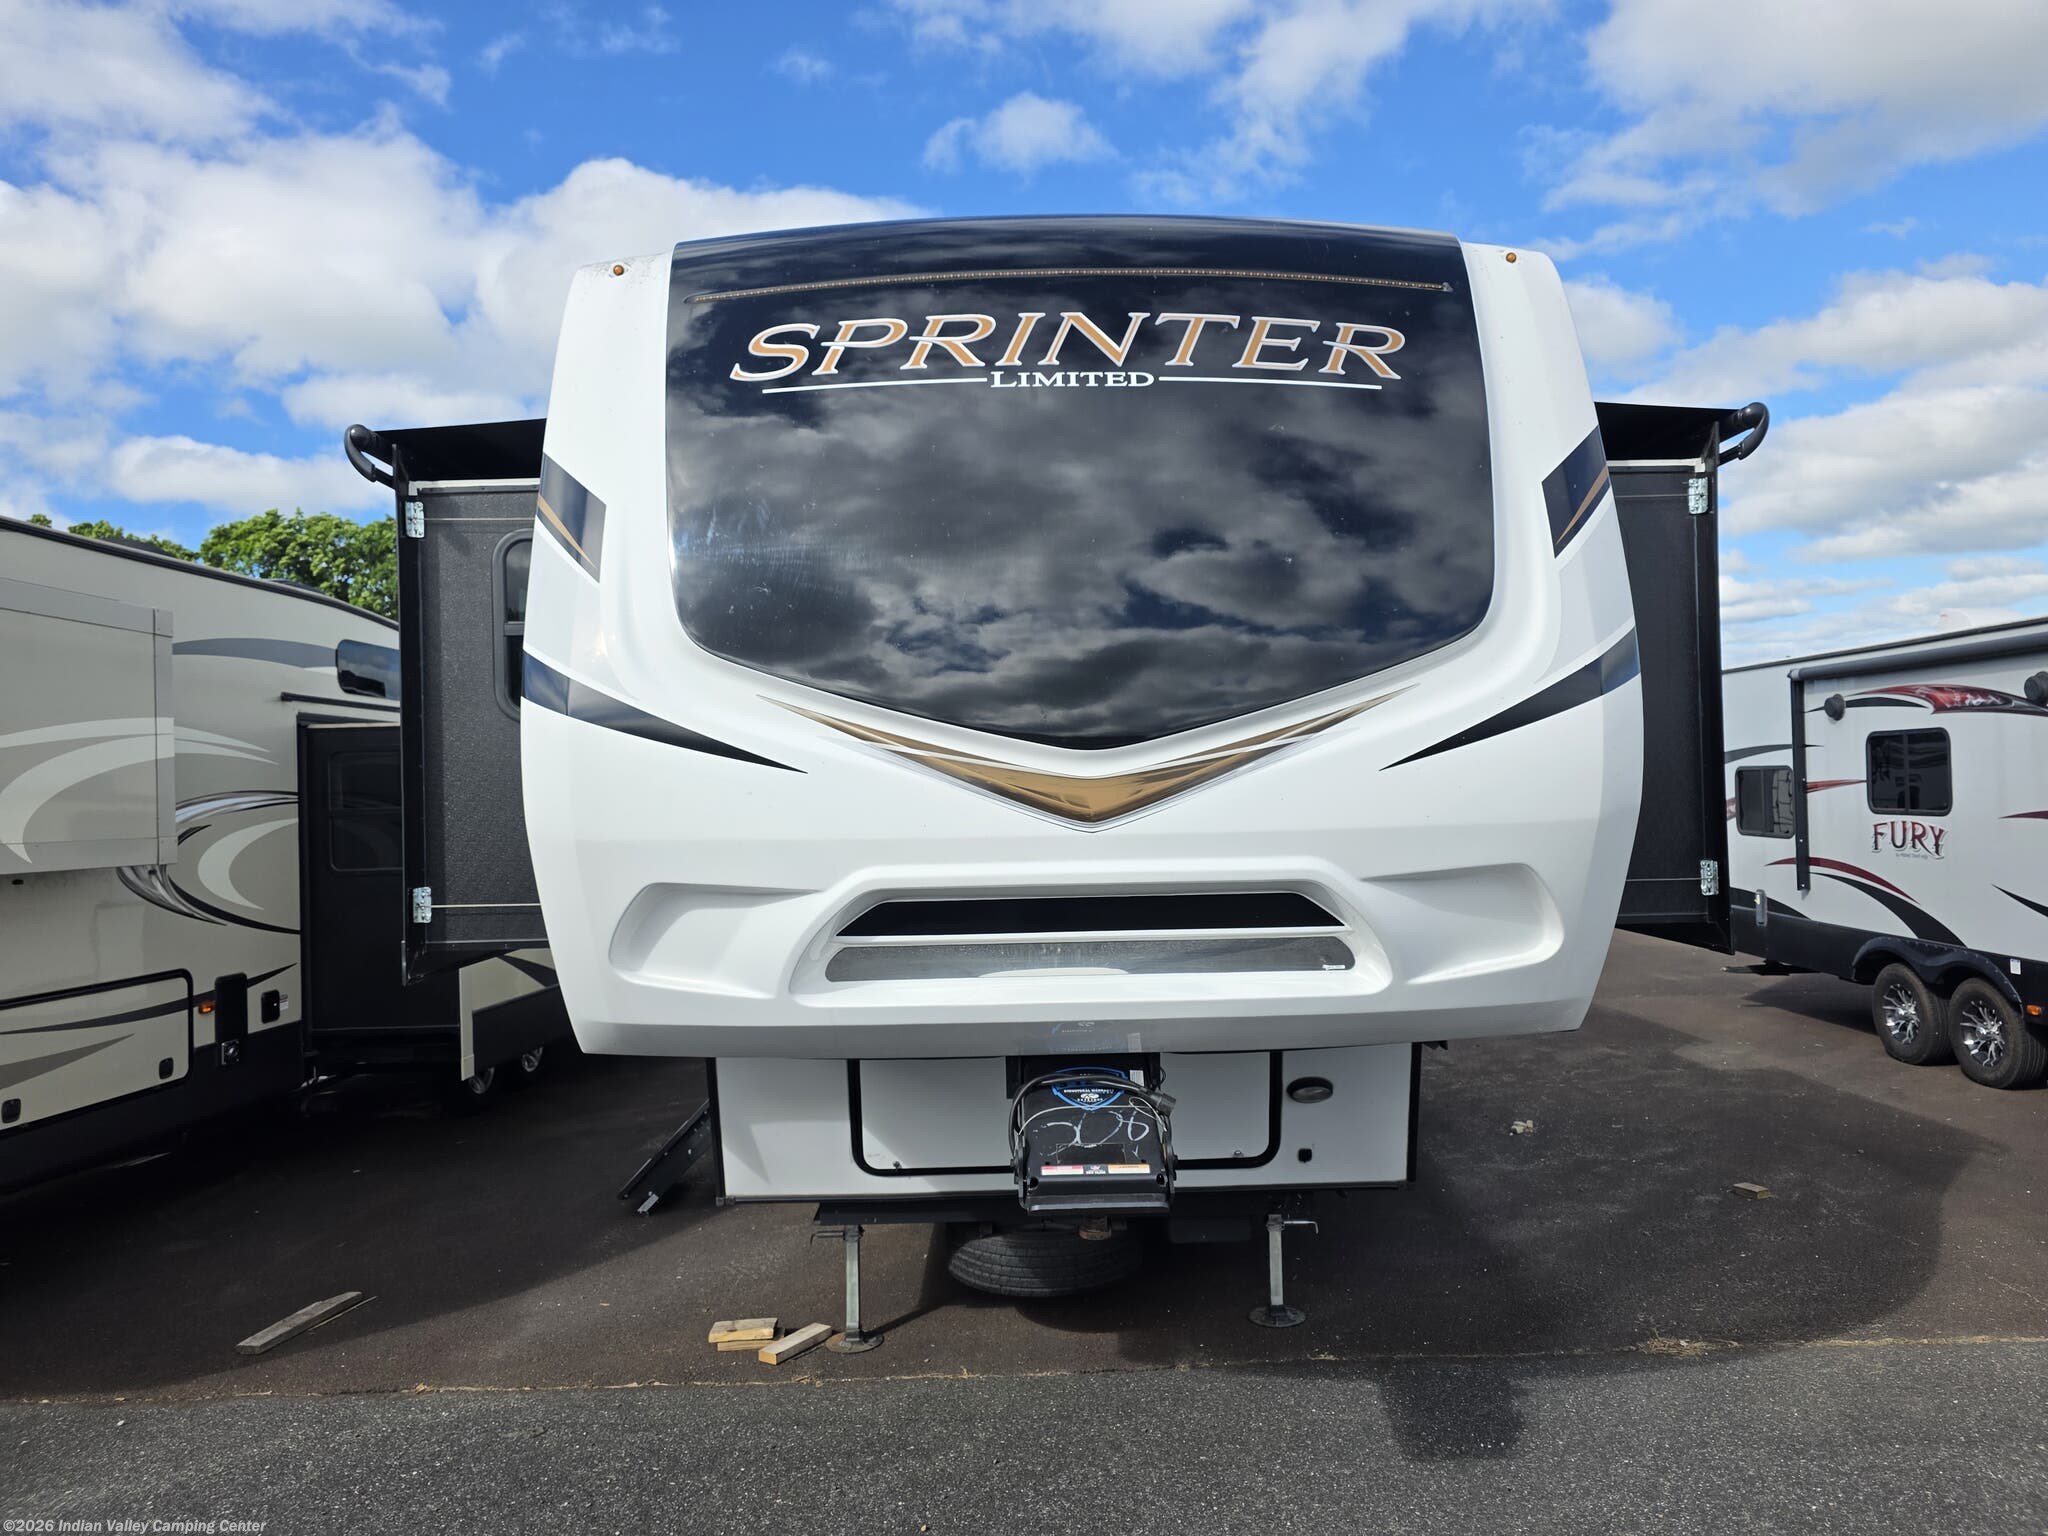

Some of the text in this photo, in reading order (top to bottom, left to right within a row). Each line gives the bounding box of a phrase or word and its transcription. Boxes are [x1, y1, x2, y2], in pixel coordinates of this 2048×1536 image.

[730, 311, 1406, 382] SPRINTER
[990, 370, 1155, 389] LIMITED
[1872, 820, 1949, 860] FURY
